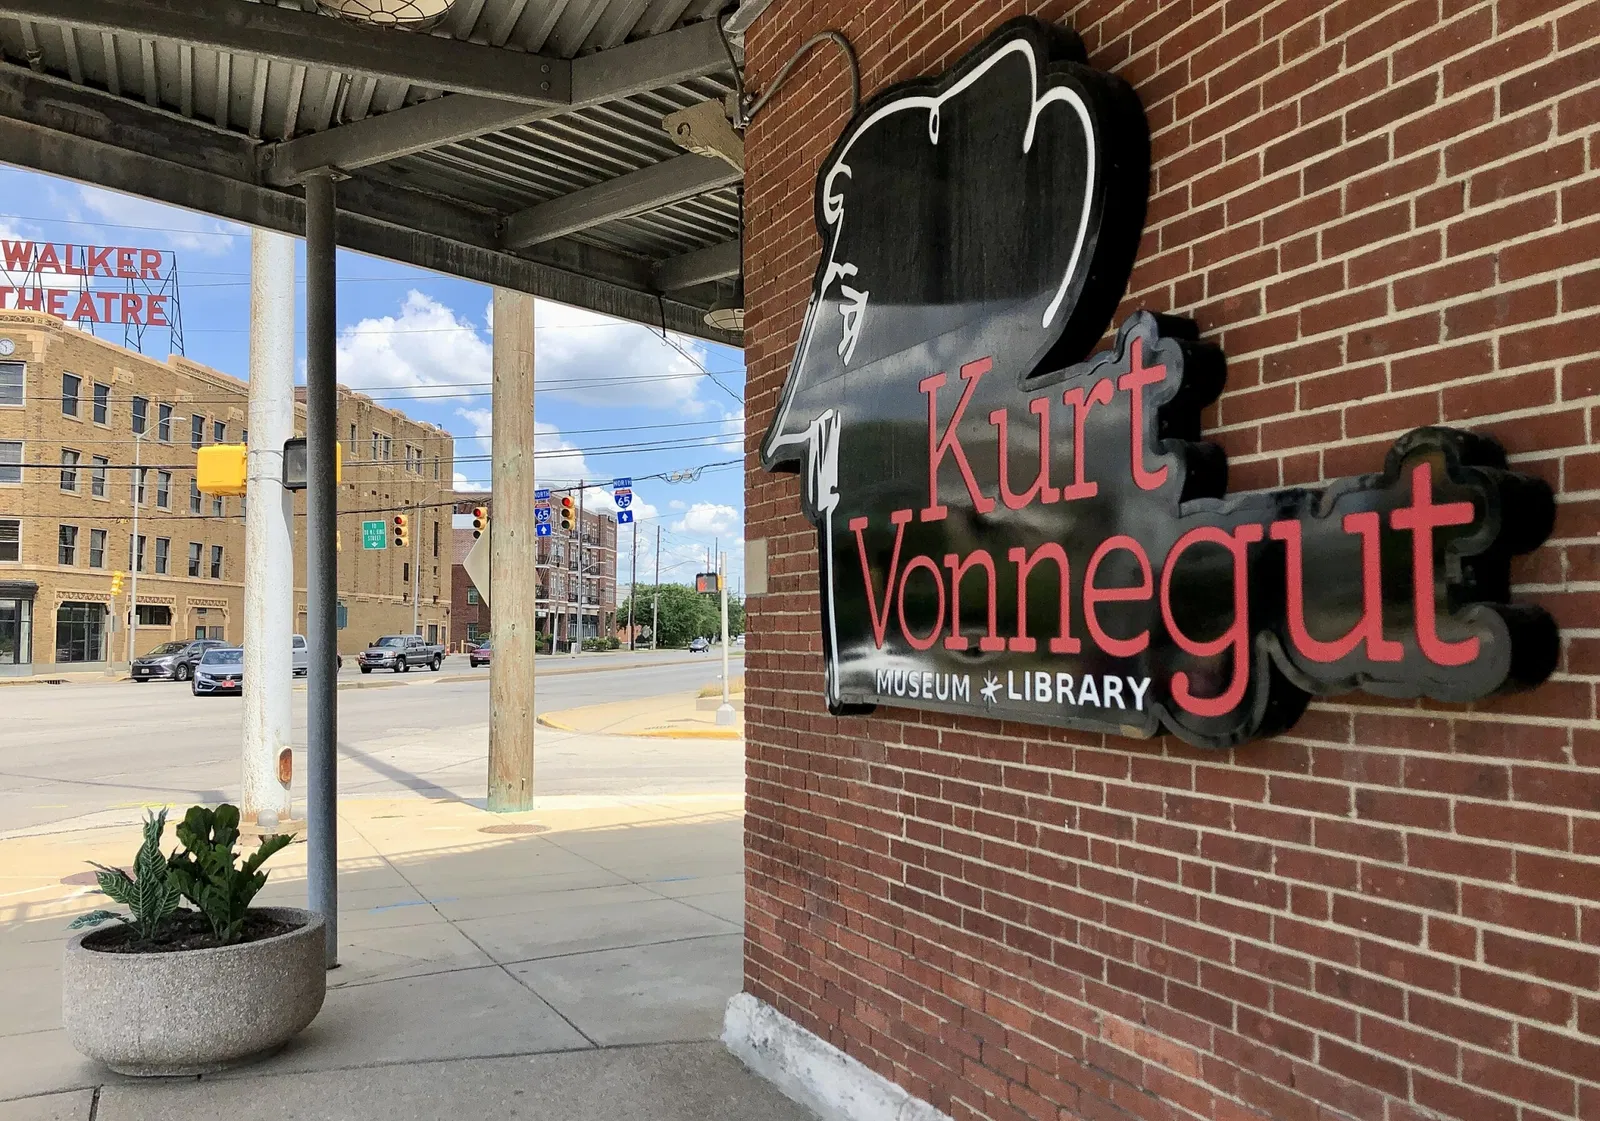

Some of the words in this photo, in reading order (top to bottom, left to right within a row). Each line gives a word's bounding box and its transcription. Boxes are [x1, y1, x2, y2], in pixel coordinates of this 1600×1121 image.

[2, 240, 162, 280] WALKER
[0, 286, 167, 326] THEATRE
[919, 336, 1169, 523] Kurt
[613, 479, 632, 487] NORTH
[618, 496, 630, 507] 65
[537, 510, 549, 520] 65
[849, 462, 1480, 717] Vonnegut
[876, 669, 970, 702] MUSEUM
[1007, 670, 1151, 711] LIBRARY
